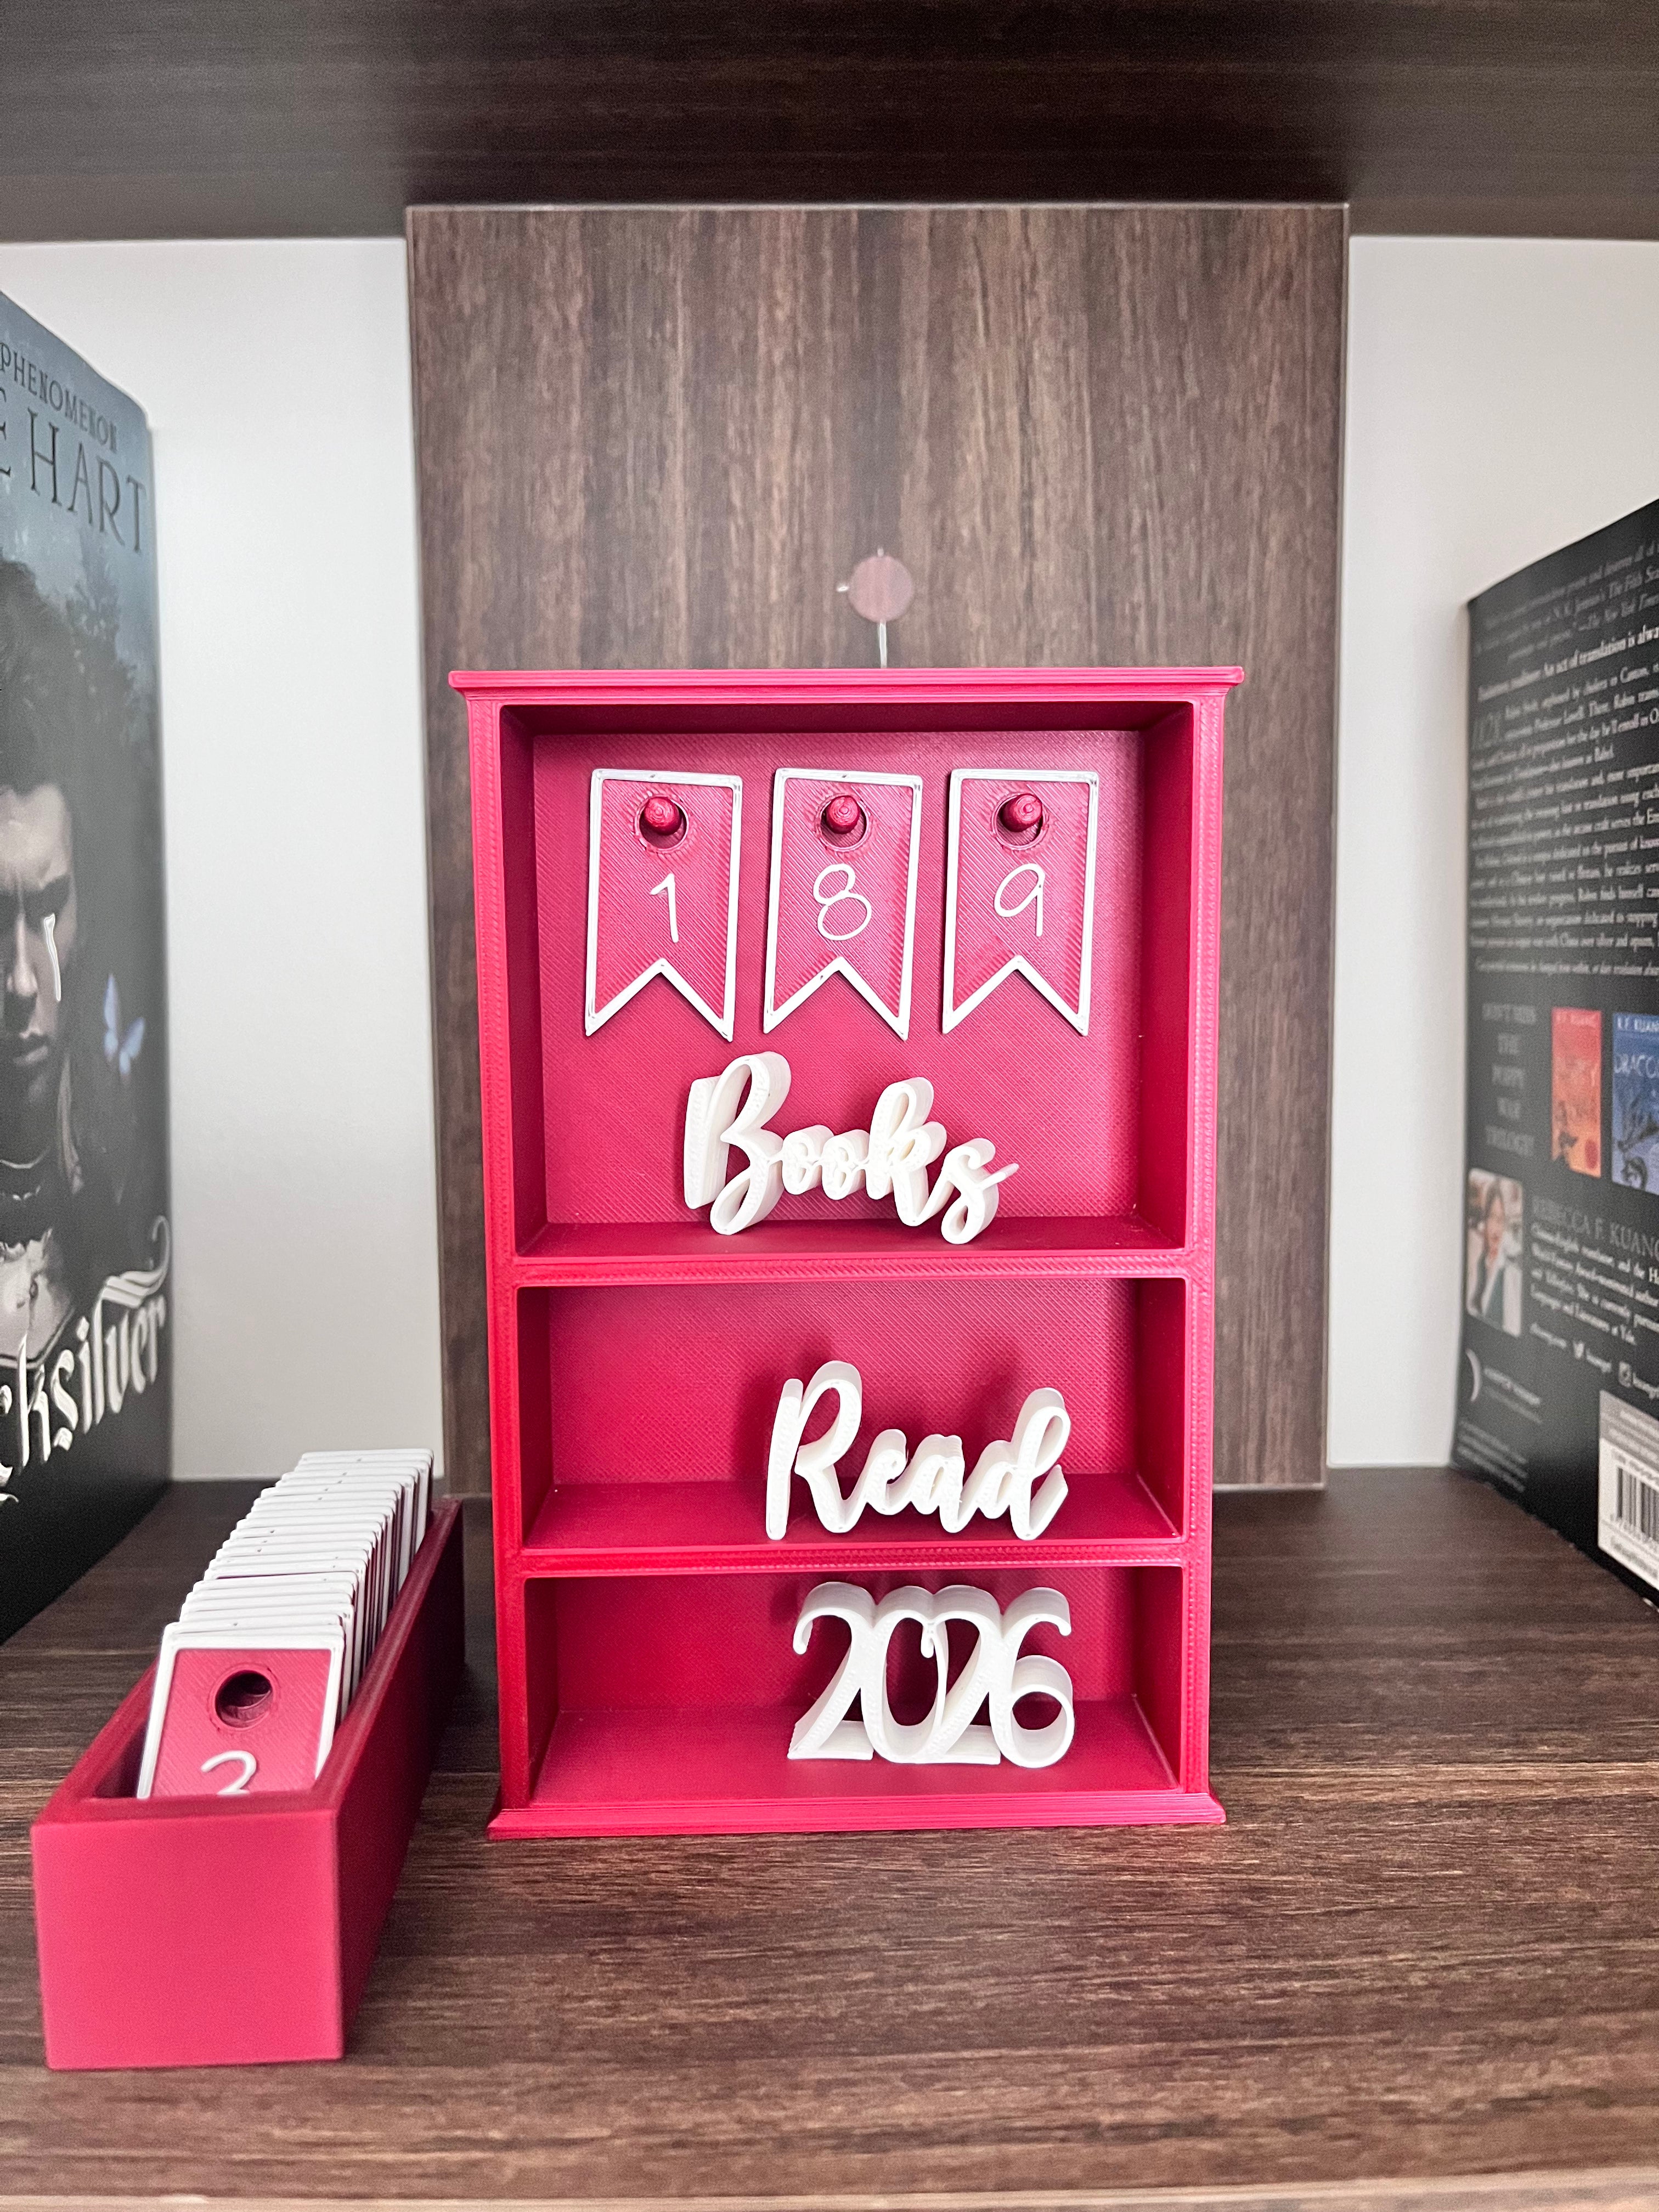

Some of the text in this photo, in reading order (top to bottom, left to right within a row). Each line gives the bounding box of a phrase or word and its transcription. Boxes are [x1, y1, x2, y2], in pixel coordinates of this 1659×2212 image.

[0, 341, 117, 453] PHENOMENON
[28, 407, 147, 554] HART
[649, 863, 1047, 943] 1 8 9
[684, 1051, 1019, 1245] Books
[766, 1361, 1071, 1541] Read
[787, 1582, 1074, 1768] 2026
[200, 1750, 257, 1796] 2
